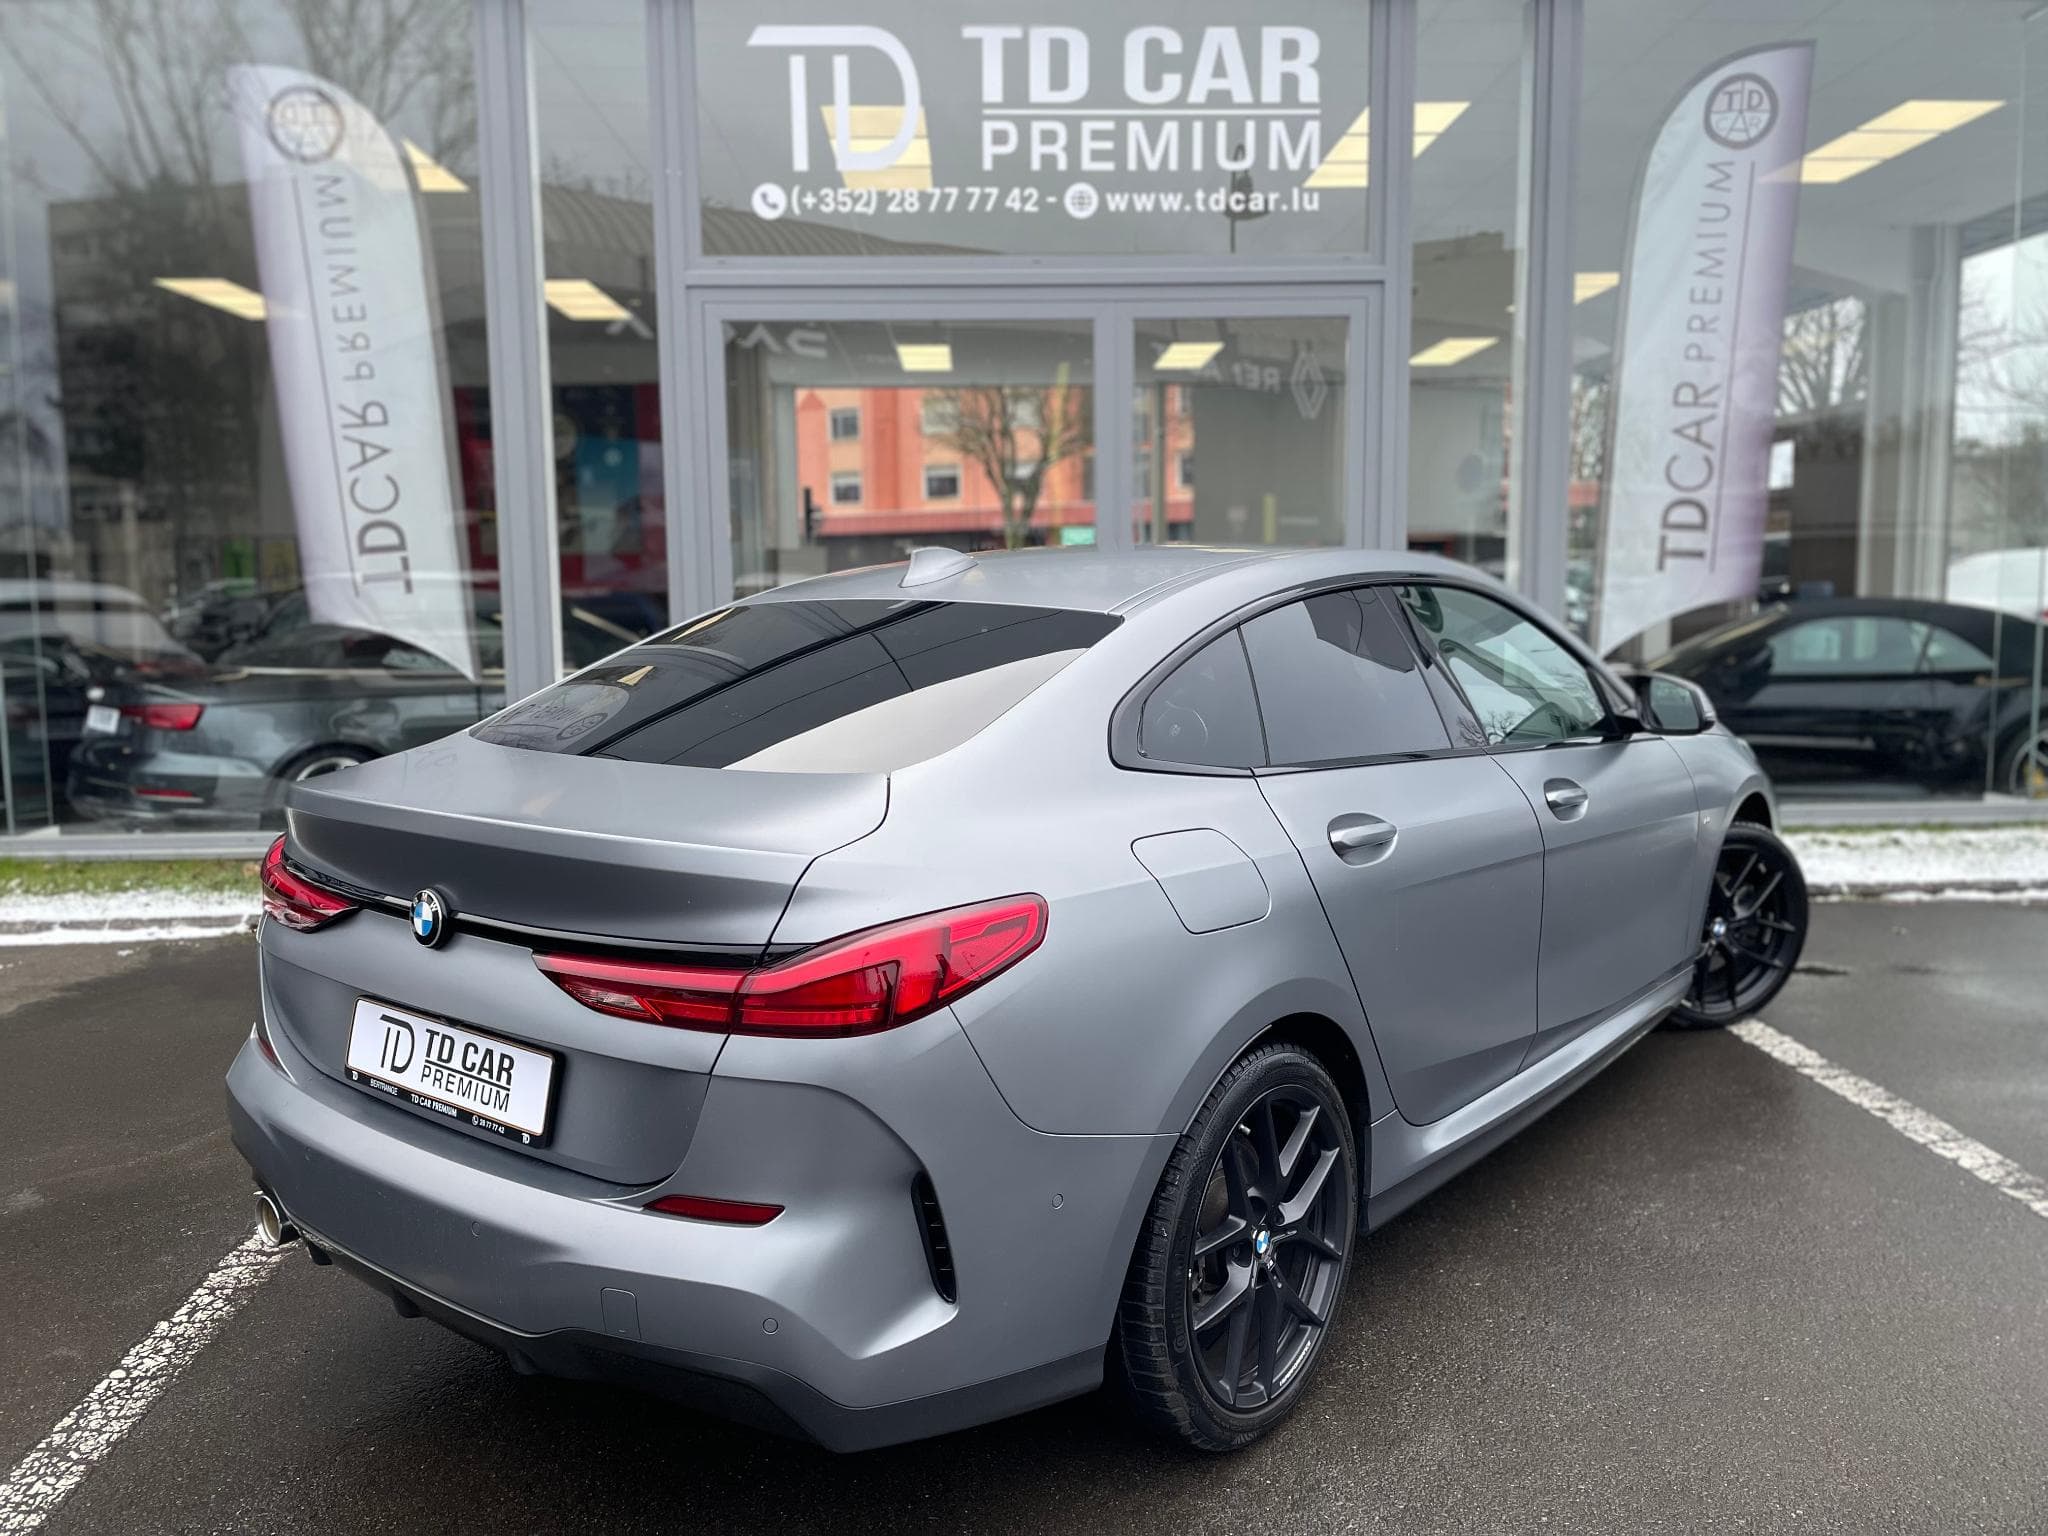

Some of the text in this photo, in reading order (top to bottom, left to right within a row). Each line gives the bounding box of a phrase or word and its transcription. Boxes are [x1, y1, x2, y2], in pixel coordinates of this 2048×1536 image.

[961, 26, 1321, 104] TD CAR
[982, 120, 1321, 171] PREMIUM
[791, 185, 878, 215] (+352)
[886, 187, 920, 213] 28
[927, 187, 959, 213] 77
[965, 187, 999, 213] 77
[1004, 187, 1040, 213] 42
[1105, 187, 1320, 213] www.tdcar.lu
[1683, 161, 1735, 362] PREMIUM
[425, 1028, 515, 1086] TD CAR
[410, 1094, 457, 1117] TD CAR PREMIUM
[420, 1064, 511, 1113] PREMIUM
